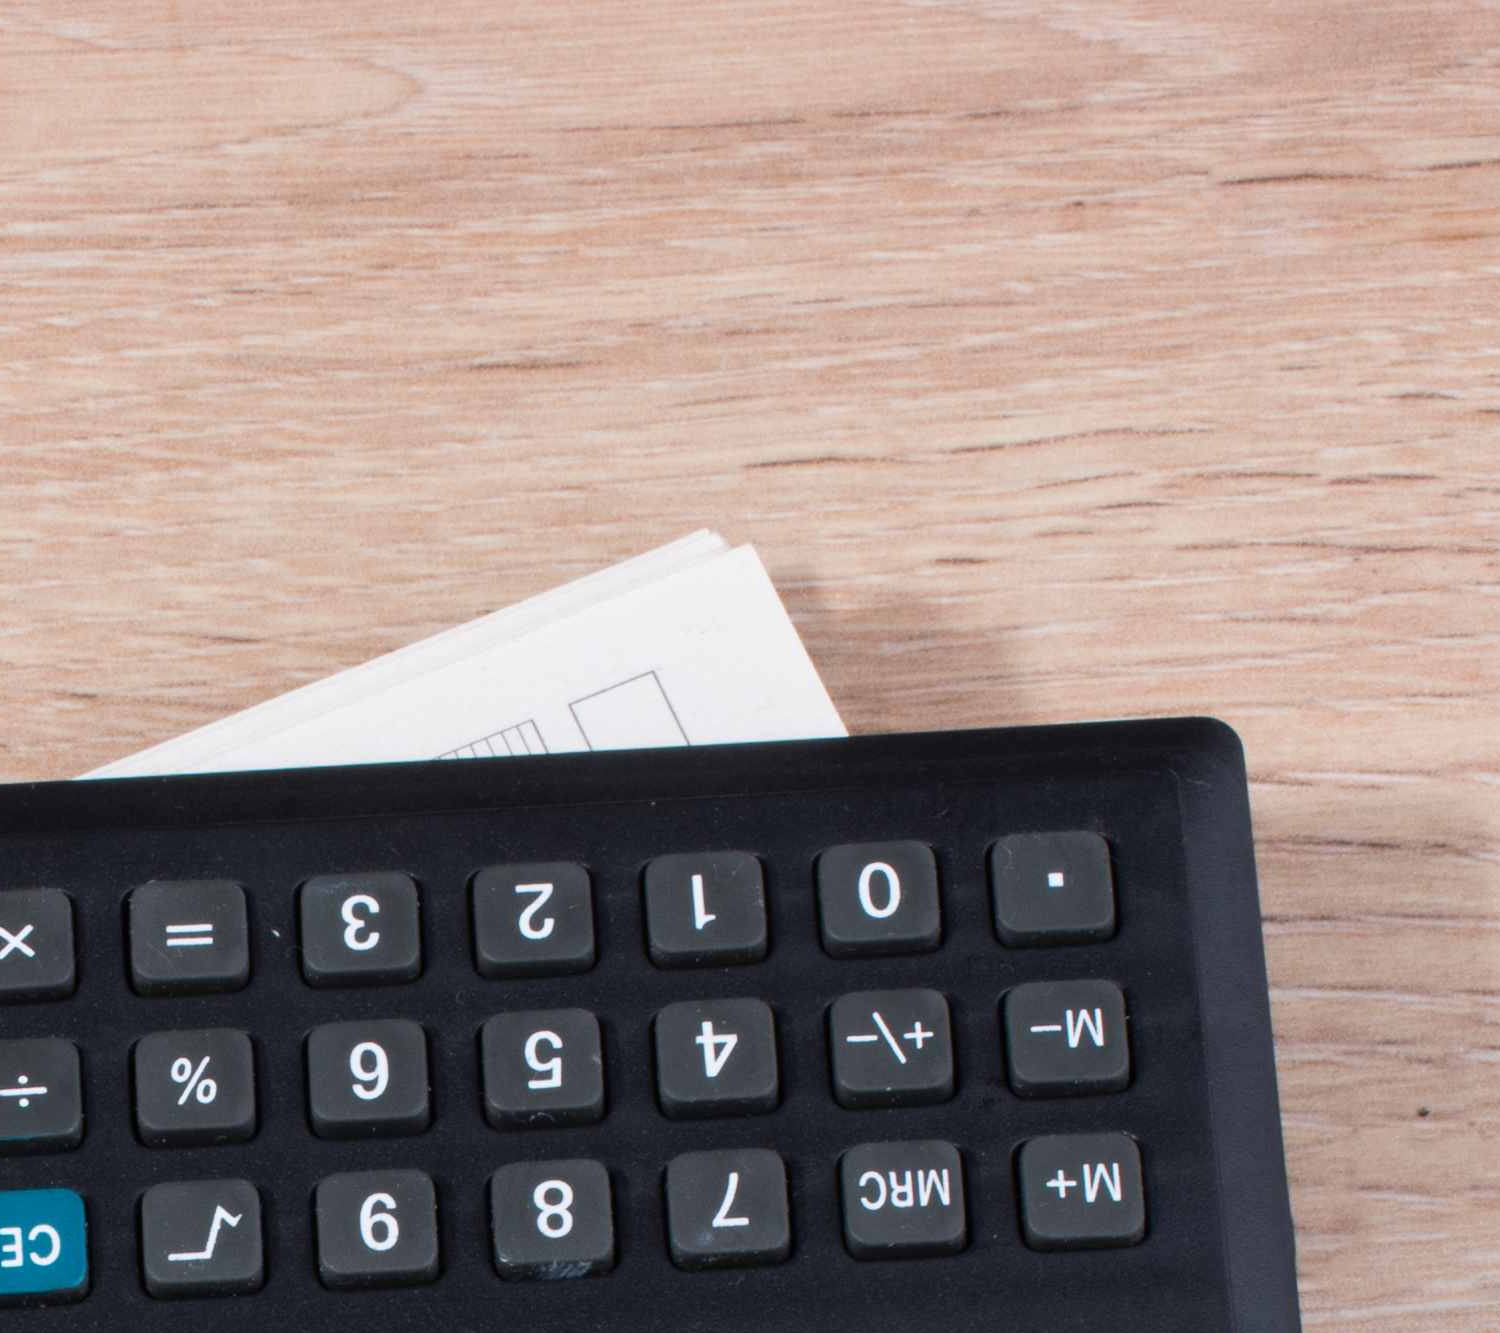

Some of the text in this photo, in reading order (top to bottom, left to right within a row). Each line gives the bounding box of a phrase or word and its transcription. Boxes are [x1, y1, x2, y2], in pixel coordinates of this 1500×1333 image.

[515, 882, 555, 940] 2
[691, 874, 717, 930] 1
[858, 861, 901, 919] 0
[341, 894, 380, 951] 3
[349, 1041, 389, 1100] 6
[524, 1030, 563, 1090] 5
[695, 1020, 738, 1078] 4
[533, 1179, 574, 1239] 8
[711, 1172, 750, 1228] 7
[858, 1168, 951, 1211] MRC
[359, 1192, 400, 1251] 9
